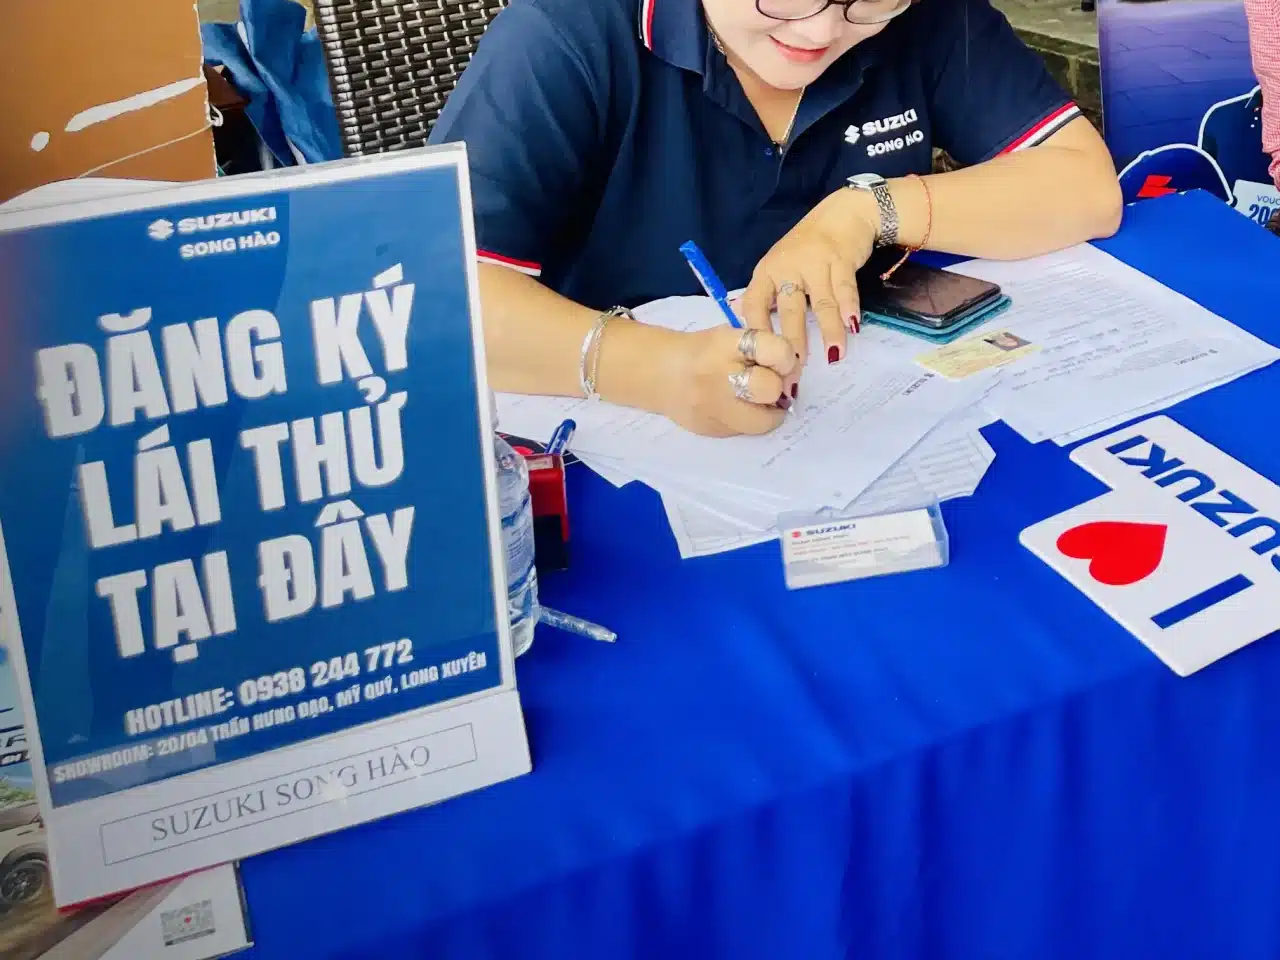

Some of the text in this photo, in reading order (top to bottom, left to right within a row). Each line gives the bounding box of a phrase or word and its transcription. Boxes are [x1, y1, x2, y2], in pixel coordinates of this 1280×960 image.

[866, 137, 904, 157] SONG
[178, 206, 277, 234] SUZUKI
[179, 231, 281, 259] SONG HÀO
[35, 262, 415, 438] ĐĂNG KÝ
[79, 376, 408, 549] LÁI THỬ
[95, 550, 238, 663] TẠI
[259, 499, 415, 623] ĐÂY
[1150, 573, 1254, 629] I
[53, 744, 154, 784] SHOWROOM:
[253, 705, 296, 731] HƯNG
[401, 666, 439, 690] LONG
[442, 651, 487, 678] XUYÊN
[125, 638, 414, 735] HOTLINE: 0938 244 772
[151, 790, 266, 841] SUZUKI
[366, 745, 430, 782] HÀO
